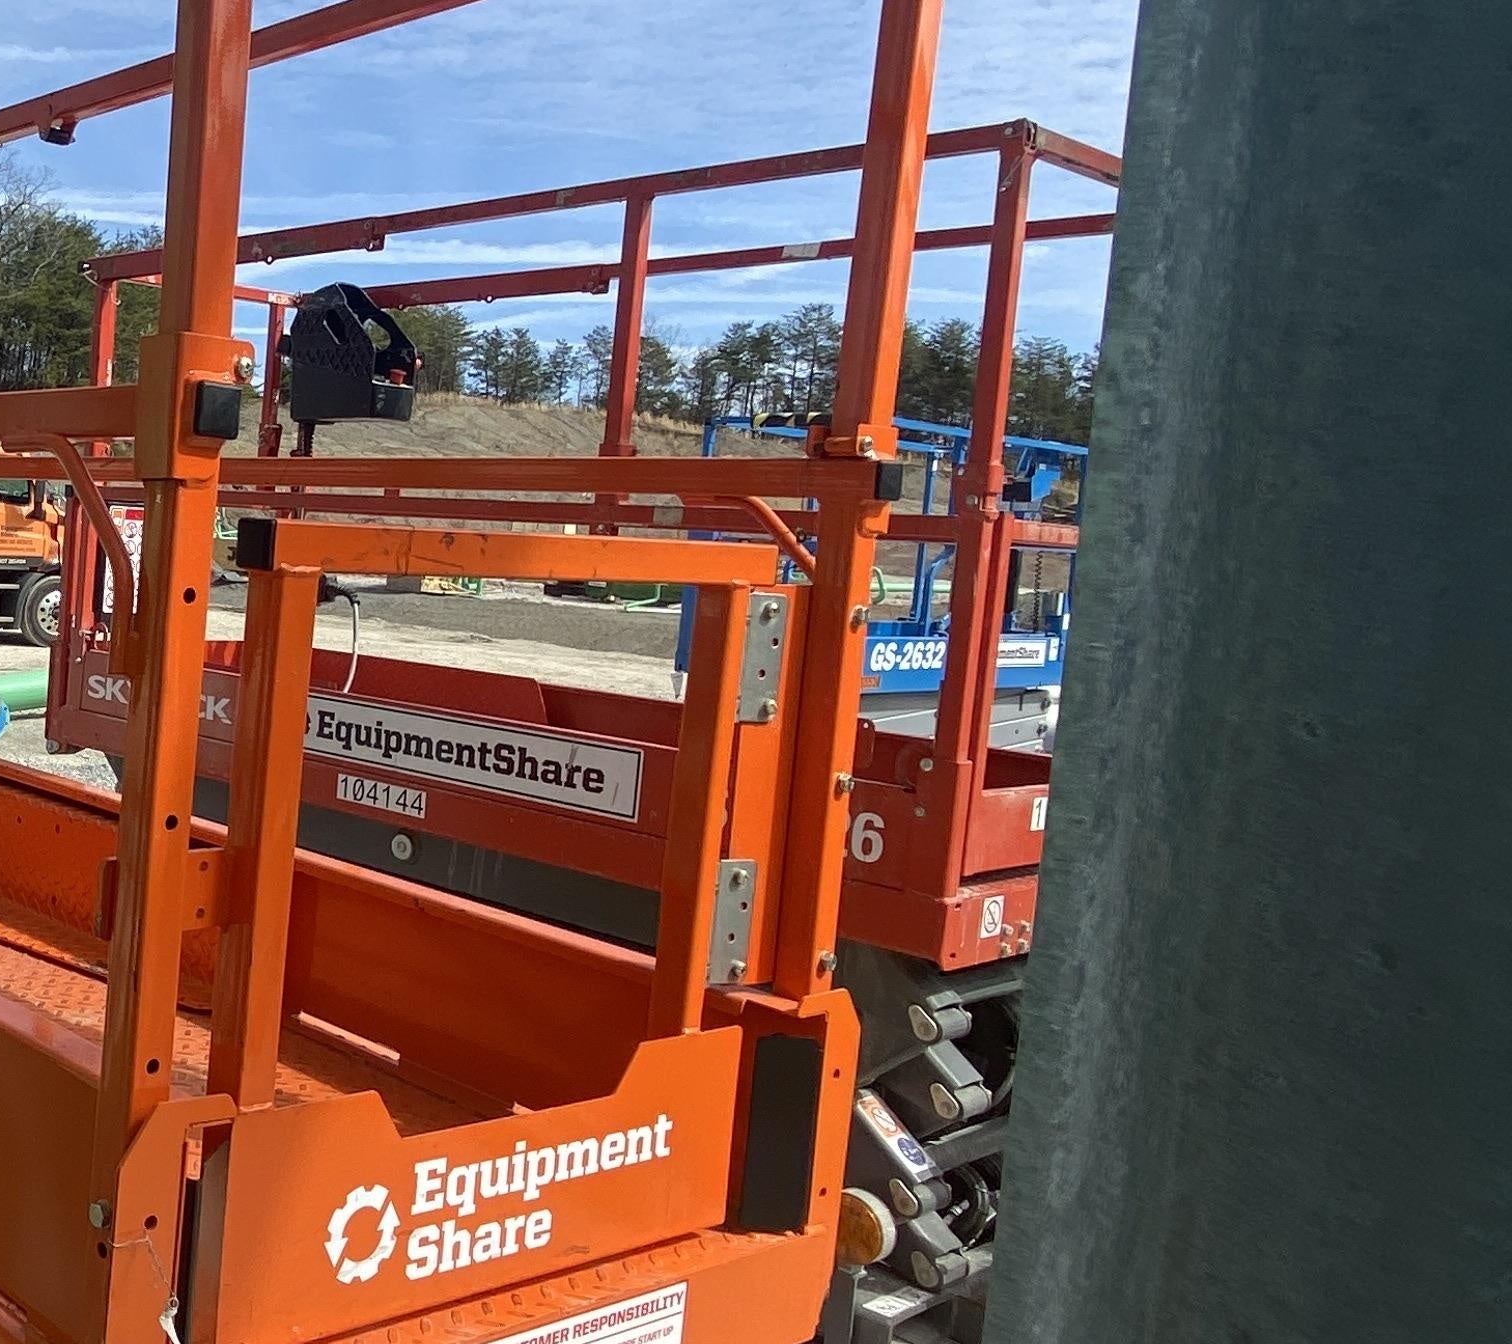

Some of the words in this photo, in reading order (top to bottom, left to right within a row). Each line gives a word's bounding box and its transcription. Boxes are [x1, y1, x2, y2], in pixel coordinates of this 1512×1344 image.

[870, 641, 947, 672] GS-2632
[317, 711, 605, 795] EquipmentShare
[338, 776, 426, 817] 104144
[850, 812, 885, 864] 6
[411, 1113, 673, 1216] Equipment
[405, 1208, 552, 1282] Share
[573, 1291, 684, 1340] RESPONSIBILITY
[663, 1325, 674, 1338] UP
